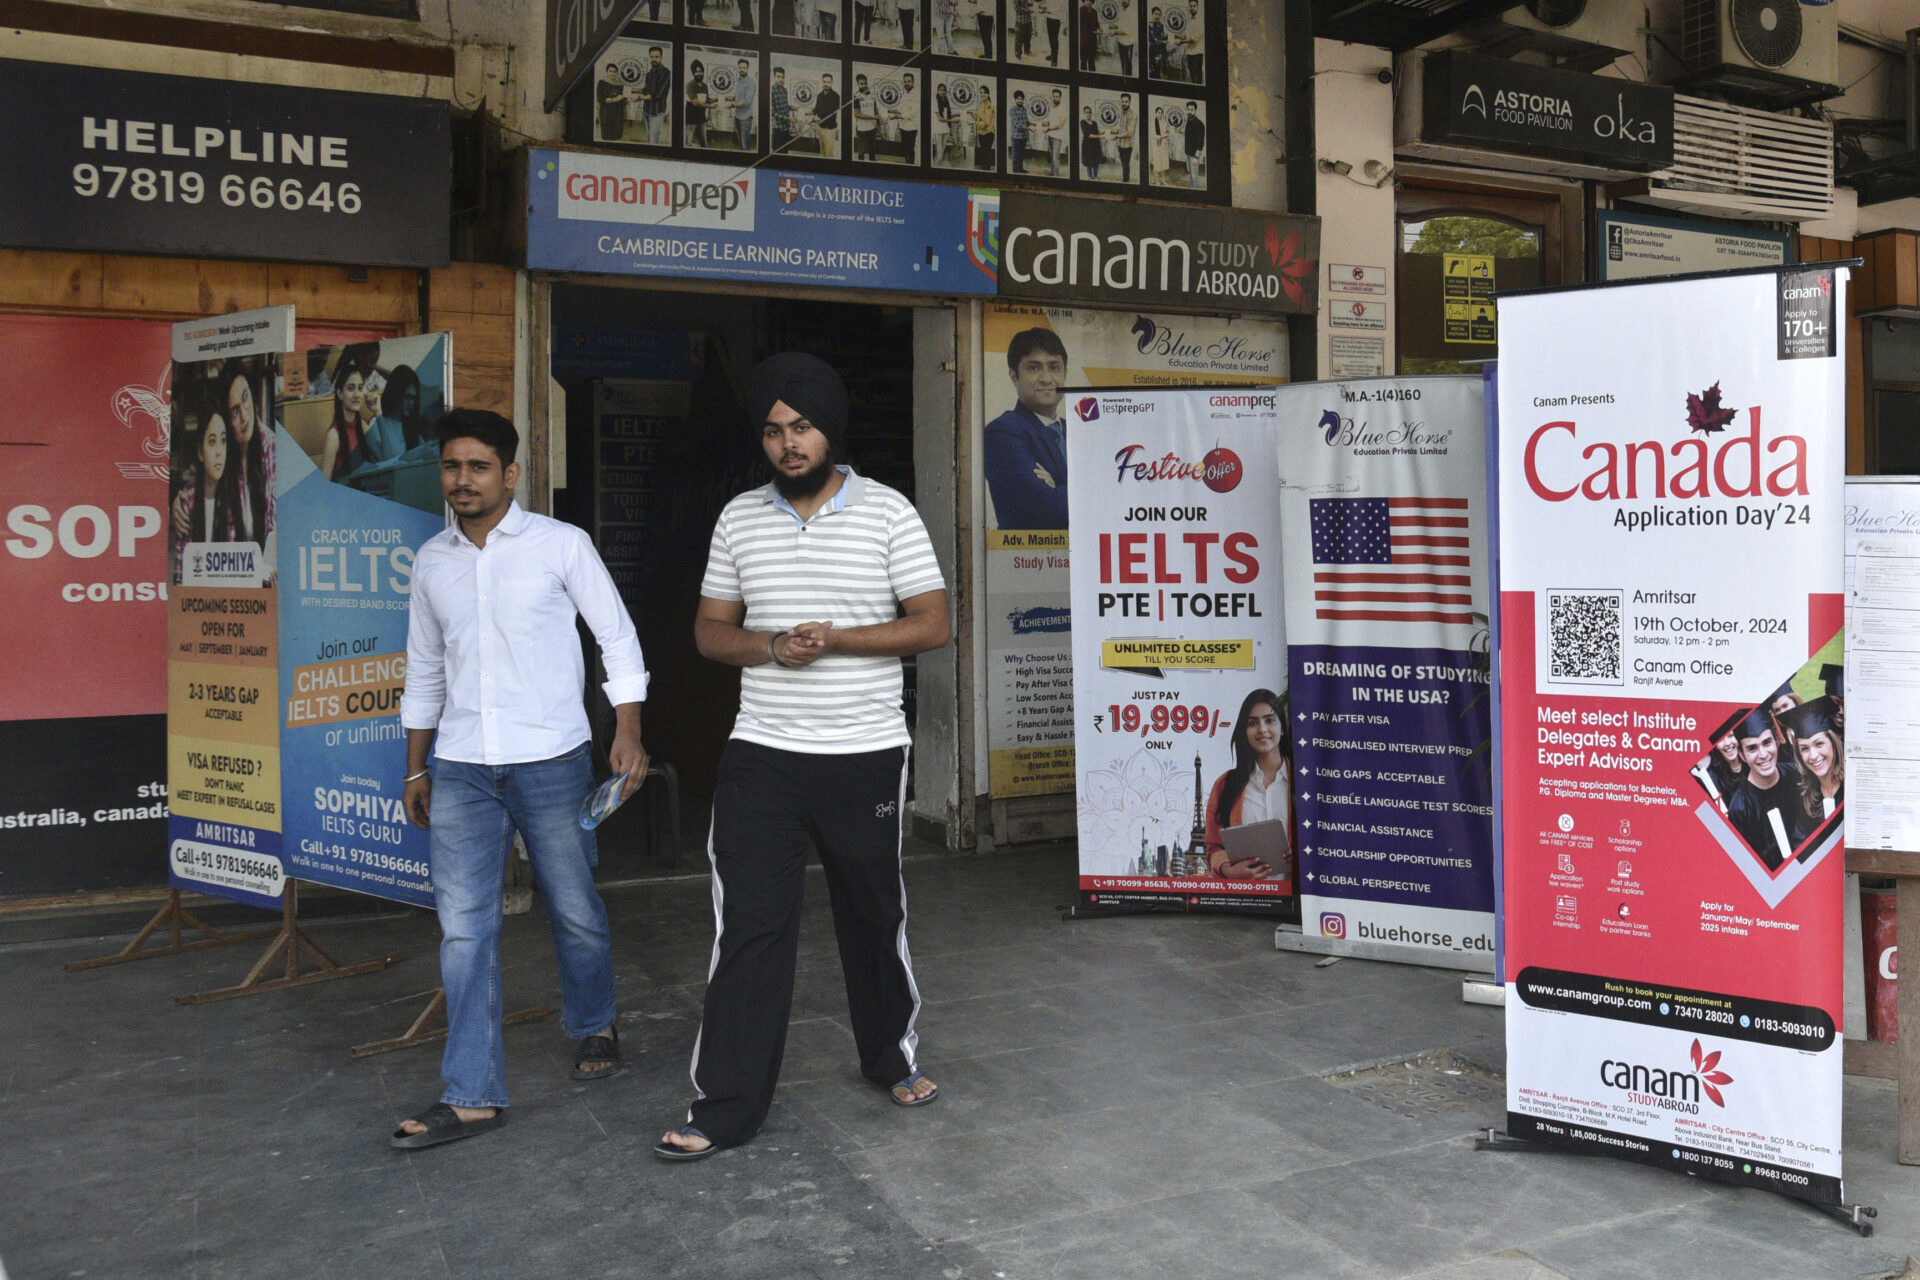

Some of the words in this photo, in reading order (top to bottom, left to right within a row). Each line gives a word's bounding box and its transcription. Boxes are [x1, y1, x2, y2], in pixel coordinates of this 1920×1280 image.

[1494, 90, 1572, 121] ASTORIA
[1494, 108, 1525, 125] FOOD
[1527, 111, 1572, 131] PAVILION
[1594, 93, 1655, 143] oka
[84, 117, 348, 168] HELPLINE
[73, 164, 204, 204] 97819
[220, 175, 361, 214] 66646
[566, 173, 738, 220] canamprep
[801, 184, 903, 207] CAMBRIDGE
[598, 236, 708, 258] CAMBRIDGE
[713, 243, 802, 265] LEARNING
[807, 250, 878, 270] PARTNER
[1198, 241, 1259, 268] STUDY
[1624, 252, 1680, 262] www.amritsarfood.in
[1757, 242, 1782, 251] PAVILION
[1006, 227, 1190, 292] canam
[1196, 270, 1279, 298] ABROAD
[1784, 287, 1820, 299] canam
[1785, 310, 1806, 318] Apply
[1785, 320, 1826, 337] 170+
[1144, 326, 1202, 357] Blue
[1207, 337, 1270, 361] Horse
[1168, 358, 1208, 368] Education
[1211, 361, 1238, 370] Private
[1241, 362, 1268, 372] Limited
[1103, 403, 1154, 415] testprepGPT
[1534, 397, 1567, 407] Canam
[1571, 394, 1614, 405] Presents
[1334, 418, 1384, 446] Blue
[1386, 422, 1447, 444] Horse
[1115, 444, 1205, 484] Festive
[1208, 462, 1235, 480] Offer
[1524, 406, 1810, 501] Canada
[1125, 507, 1165, 521] JOIN
[1170, 507, 1207, 521] OUR
[1614, 505, 1727, 532] Application
[312, 529, 358, 544] CRACK
[362, 529, 401, 544] YOUR
[1003, 534, 1024, 545] Adv.
[1028, 534, 1065, 545] Manish
[206, 552, 254, 571] SOPHIYA
[1014, 556, 1043, 571] Study
[1047, 556, 1069, 568] Visa
[1100, 532, 1260, 584] IELTS
[300, 546, 415, 594] IELTS
[181, 598, 228, 614] UPCOMING
[230, 599, 266, 614] SESSION
[1099, 593, 1150, 616] PTE
[1171, 593, 1262, 617] TOEFL
[1633, 590, 1696, 604] Amritsar
[202, 622, 224, 636] OPEN
[228, 622, 244, 638] FOR
[1634, 617, 1664, 630] 19th
[1670, 617, 1743, 633] October,
[1749, 618, 1787, 633] 2024
[317, 640, 347, 660] Join
[352, 636, 378, 653] our
[1005, 655, 1023, 664] Why
[1026, 654, 1055, 662] Choose
[1115, 644, 1180, 653] UNLIMITED
[1164, 656, 1182, 664] YOU
[1304, 662, 1386, 678] DREAMING
[1392, 665, 1411, 679] OF
[1634, 658, 1685, 673] Canam
[1690, 660, 1733, 675] Office
[1634, 676, 1653, 686] Ranjit
[1655, 677, 1683, 686] Avenue
[189, 683, 203, 700] 2-3
[206, 685, 236, 703] YEARS
[239, 687, 258, 704] GAP
[1132, 692, 1156, 700] JUST
[1160, 692, 1180, 700] PAY
[1353, 688, 1370, 700] IN
[1374, 688, 1404, 702] THE
[1408, 690, 1449, 704] USA?
[288, 696, 340, 721] IELTS
[1312, 712, 1329, 721] PAY
[1332, 714, 1364, 723] AFTER
[1367, 715, 1390, 724] VISA
[1538, 707, 1576, 724] Meet
[1582, 710, 1628, 726] select
[1634, 712, 1696, 730] Institute
[1109, 704, 1231, 738] 19,999/-
[1146, 741, 1172, 749] ONLY
[1538, 728, 1616, 749] Delegates
[1622, 732, 1632, 748] &
[1638, 733, 1700, 752] Canam
[187, 752, 209, 770] VISA
[212, 755, 254, 775] REFUSED
[1538, 748, 1585, 768] Expert
[1589, 752, 1652, 771] Advisors
[1316, 768, 1340, 778] LONG
[1344, 770, 1371, 779] GAPS
[1377, 772, 1445, 784] ACCEPTABLE
[314, 786, 407, 825] SOPHIYA
[196, 822, 255, 847] AMRITSAR
[322, 815, 355, 835] IELTS
[360, 822, 401, 844] GURU
[216, 854, 278, 880] 9781966646
[347, 848, 428, 876] 9781966646
[1117, 880, 1170, 888] 70099-85635,
[1172, 882, 1225, 890] 70090-07821,
[1320, 875, 1360, 886] GLOBAL
[1362, 878, 1430, 892] PERSPECTIVE
[1605, 982, 1624, 992] Rush
[1626, 986, 1633, 994] to
[1635, 987, 1654, 997] book
[1656, 992, 1672, 1000] your
[1674, 994, 1722, 1007] appointment
[1528, 984, 1651, 1010] www.canamgroup.com
[1675, 1005, 1702, 1019] 73470
[1706, 1010, 1734, 1024] 28020
[1755, 1018, 1824, 1038] 0183-5093010
[1600, 1060, 1699, 1102] canam
[1546, 1124, 1564, 1134] Years
[1570, 1129, 1597, 1141] 1,85,000
[1598, 1134, 1624, 1146] Success
[1626, 1140, 1649, 1151] Stories
[1682, 1151, 1699, 1162] 1800
[1701, 1155, 1712, 1164] 137
[1714, 1158, 1734, 1169] 8055
[1755, 1167, 1780, 1179] 89683
[1782, 1172, 1808, 1185] 00000
